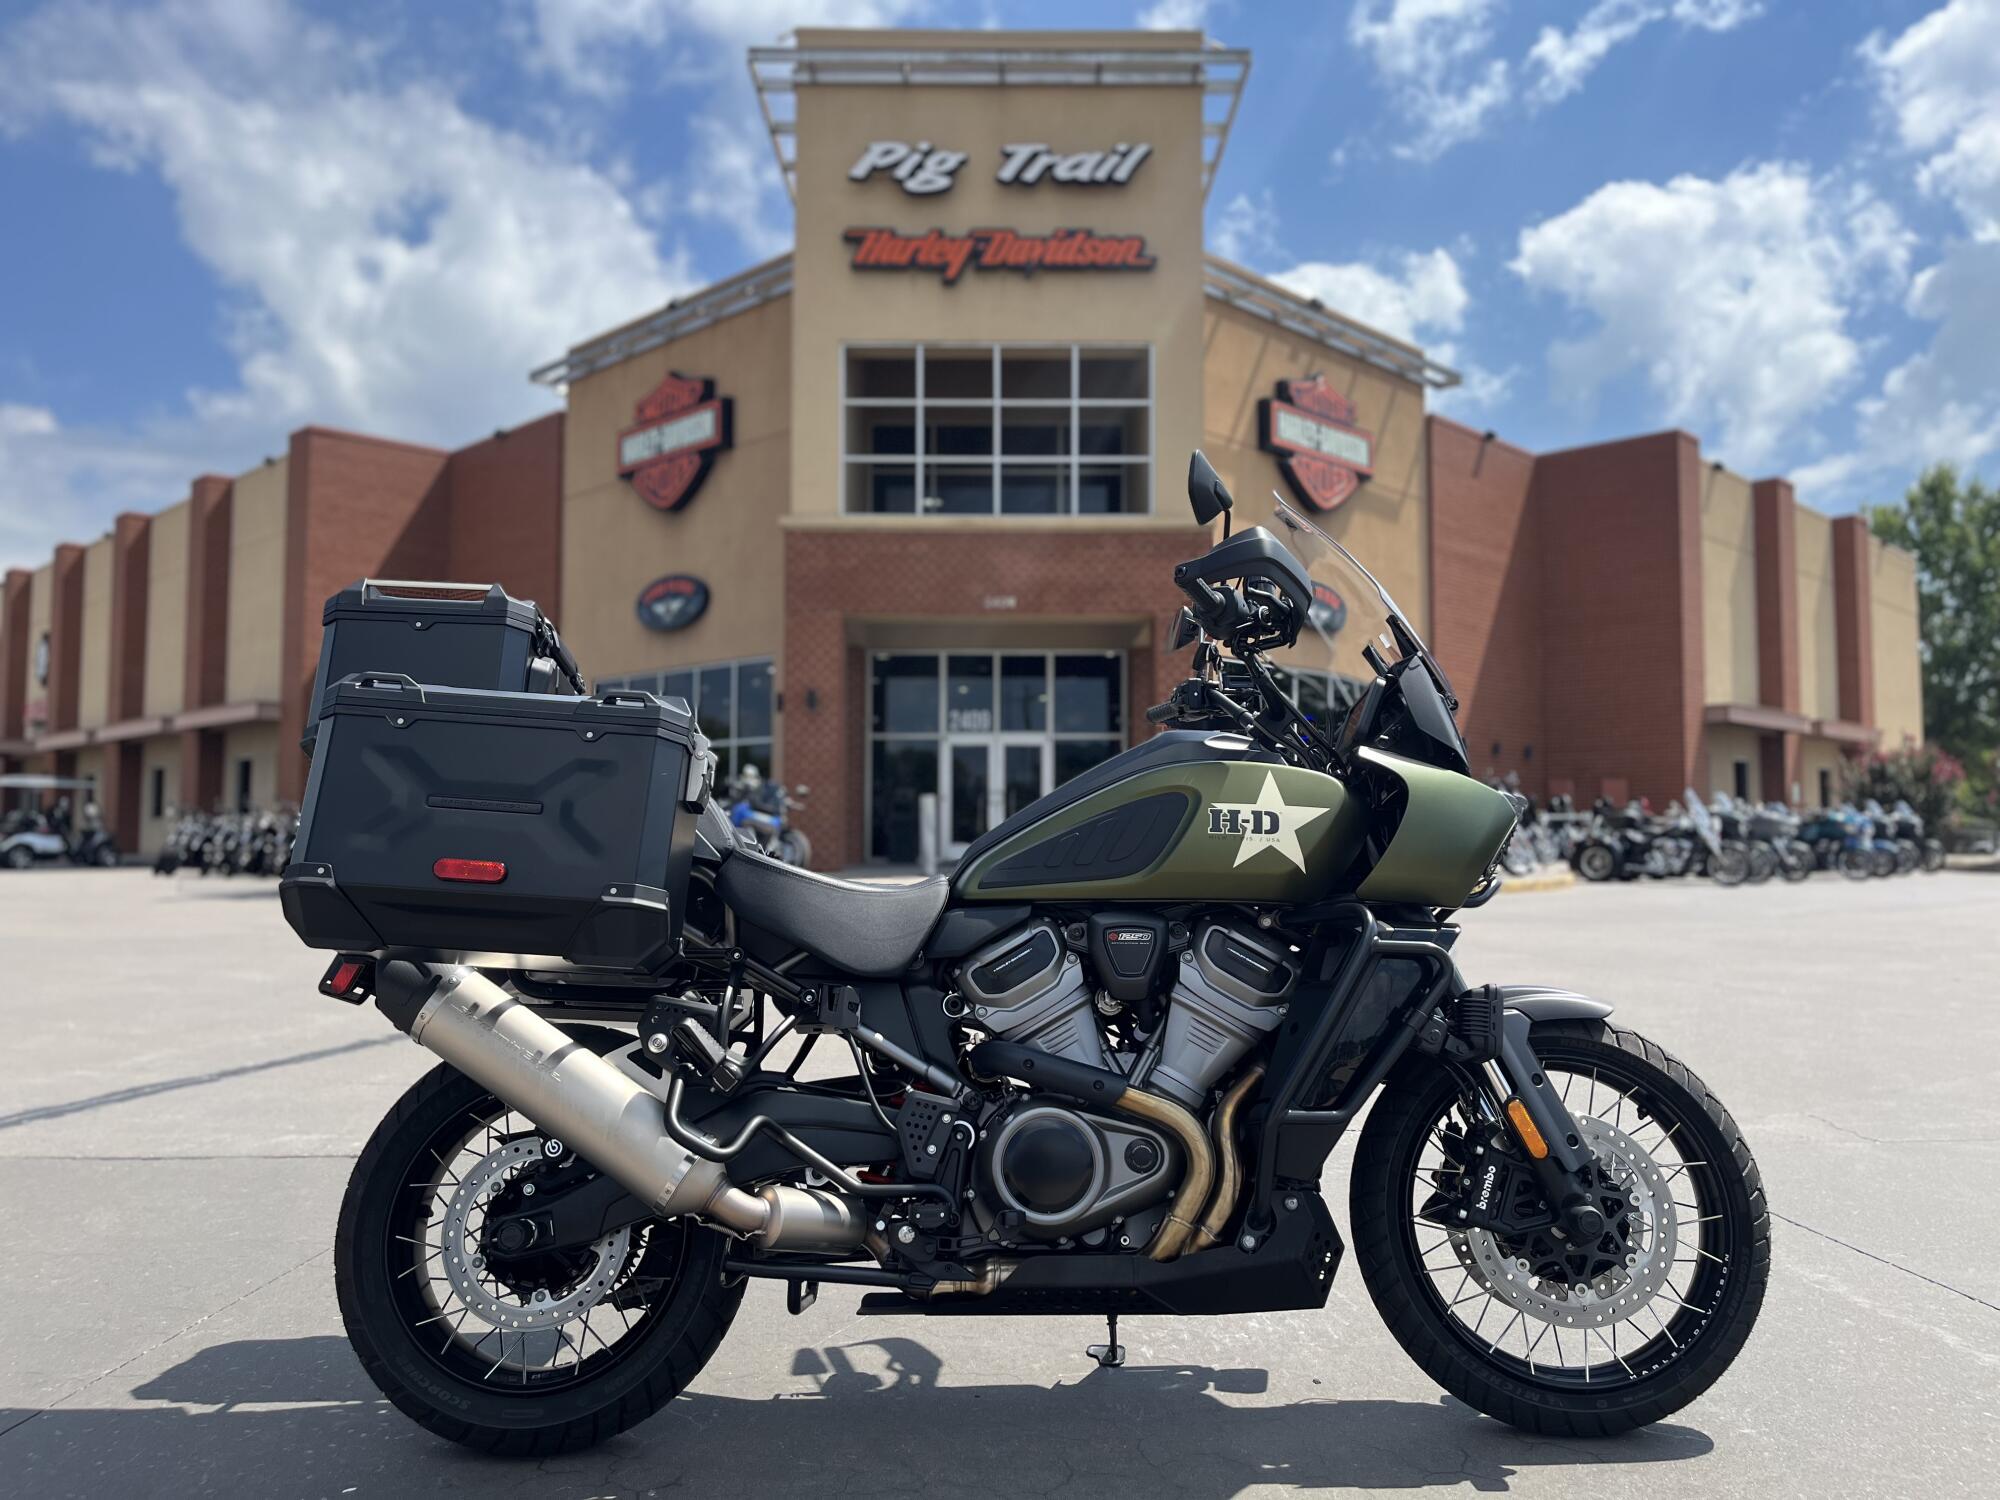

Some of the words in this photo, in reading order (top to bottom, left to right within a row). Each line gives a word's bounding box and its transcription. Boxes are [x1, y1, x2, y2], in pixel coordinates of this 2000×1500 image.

[849, 141, 968, 194] Pig
[996, 142, 1151, 183] Trail
[1208, 808, 1280, 835] H-D
[1118, 932, 1152, 941] 1250
[1475, 1165, 1497, 1210] brembo
[1629, 1253, 1730, 1380] HARLEY-DAVIDSON
